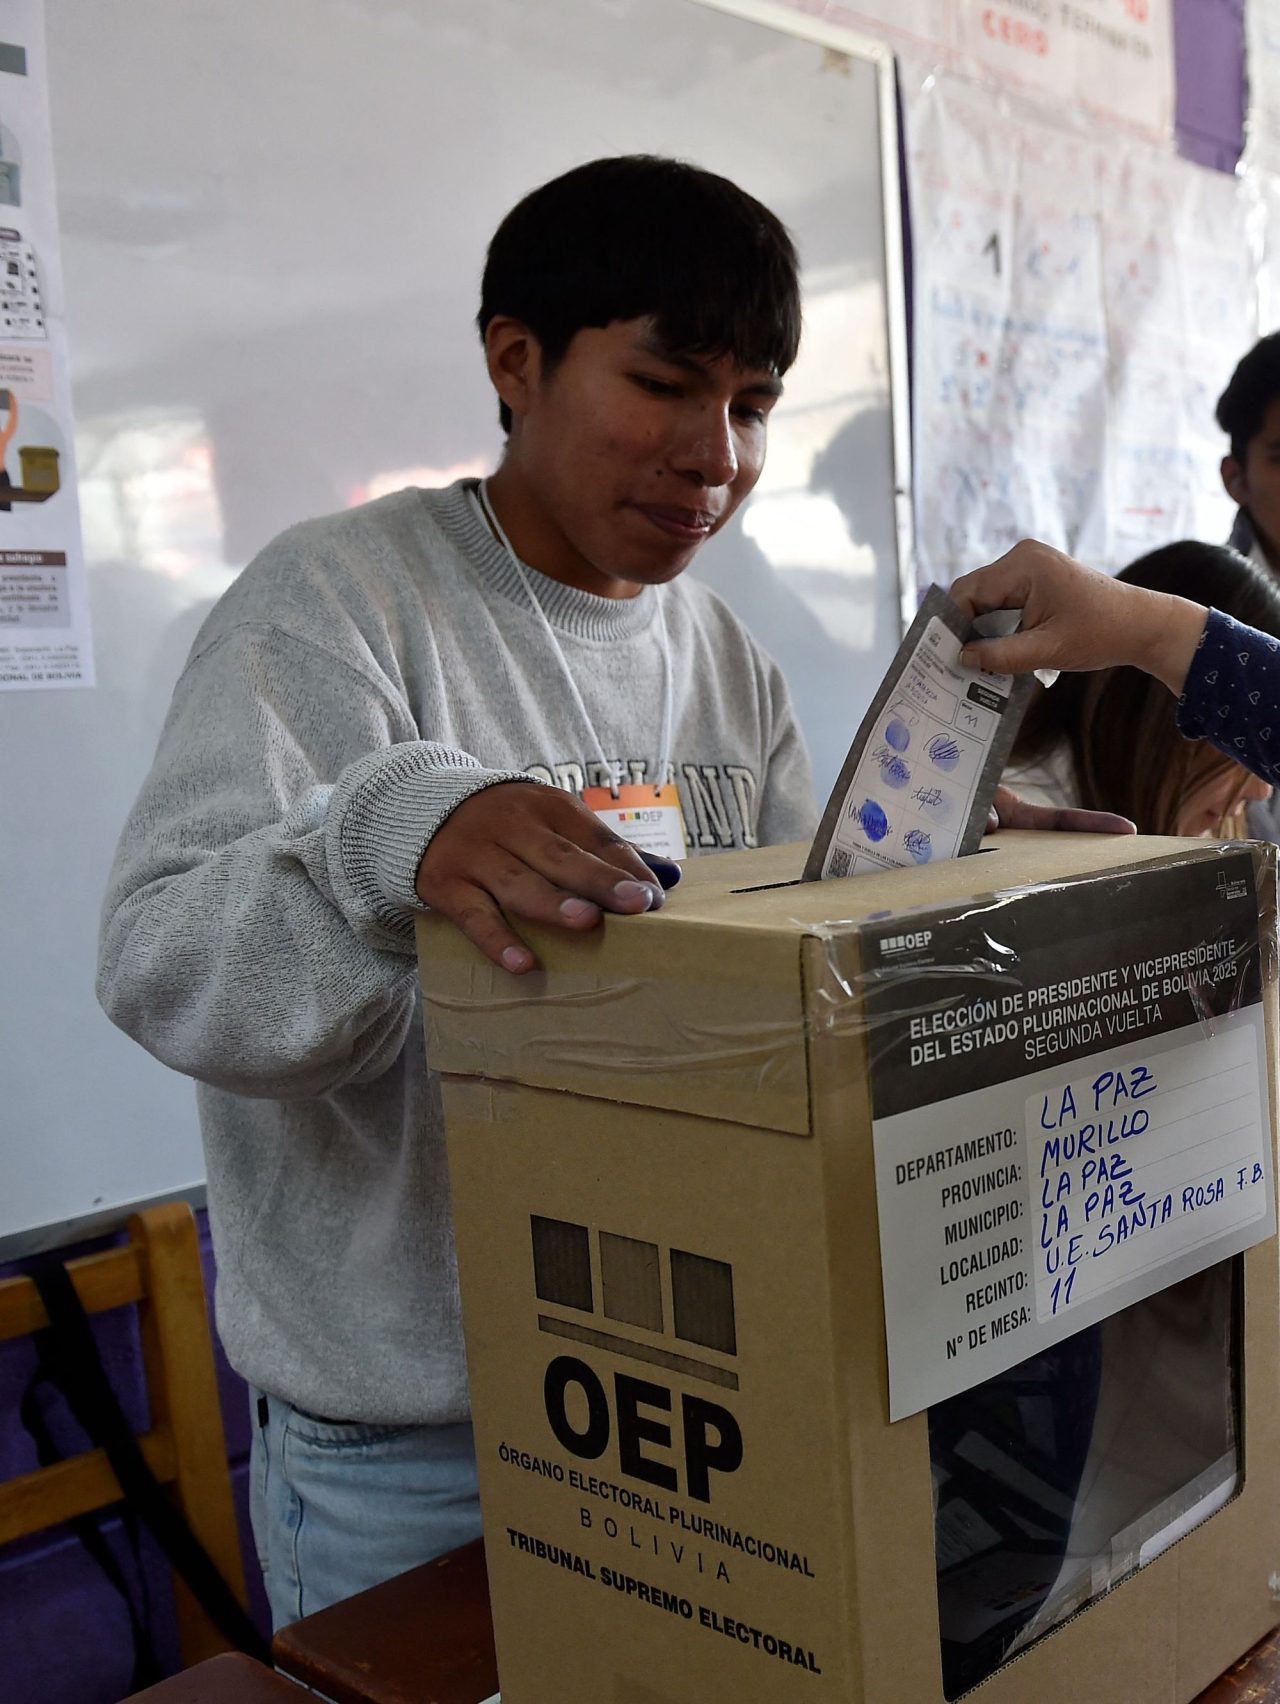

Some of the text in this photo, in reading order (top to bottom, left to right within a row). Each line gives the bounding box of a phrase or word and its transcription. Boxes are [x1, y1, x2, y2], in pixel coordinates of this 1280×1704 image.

[905, 930, 932, 949] OEP
[910, 940, 1237, 1040] ELECCIÓN DE PRESIDENTE Y VICEPRESIDENTE
[910, 960, 1238, 1067] DEL ESTADO PLURINACIONAL DE BOLIVIA 2025
[1024, 1003, 1163, 1061] SEGUNDA VUELTA
[1040, 1065, 1158, 1129] LA PAZ
[895, 1128, 1017, 1185] DEPARTAMENTO:
[1040, 1109, 1149, 1178] MURILLO
[941, 1165, 1022, 1208] PROVINCIA:
[1042, 1153, 1133, 1209] LA PAZ
[944, 1203, 1024, 1246] MUNICIPIO:
[1040, 1180, 1146, 1249] LA PAZ
[1092, 1195, 1173, 1257] SANTA
[1182, 1177, 1224, 1213] ROSA
[940, 1239, 1023, 1285] LOCALIDAD:
[965, 1272, 1029, 1313] RECINTO:
[1050, 1268, 1077, 1315] 11
[968, 1327, 987, 1351] DE
[991, 1308, 1031, 1341] MESA:
[544, 1355, 743, 1504] OEP
[499, 1441, 816, 1578] ÓRGANO ELECTORAL PLURINACIONAL
[581, 1508, 731, 1584] BOLIVIA
[507, 1527, 823, 1675] TRIBUNAL SUPREMO ELECTORAL
